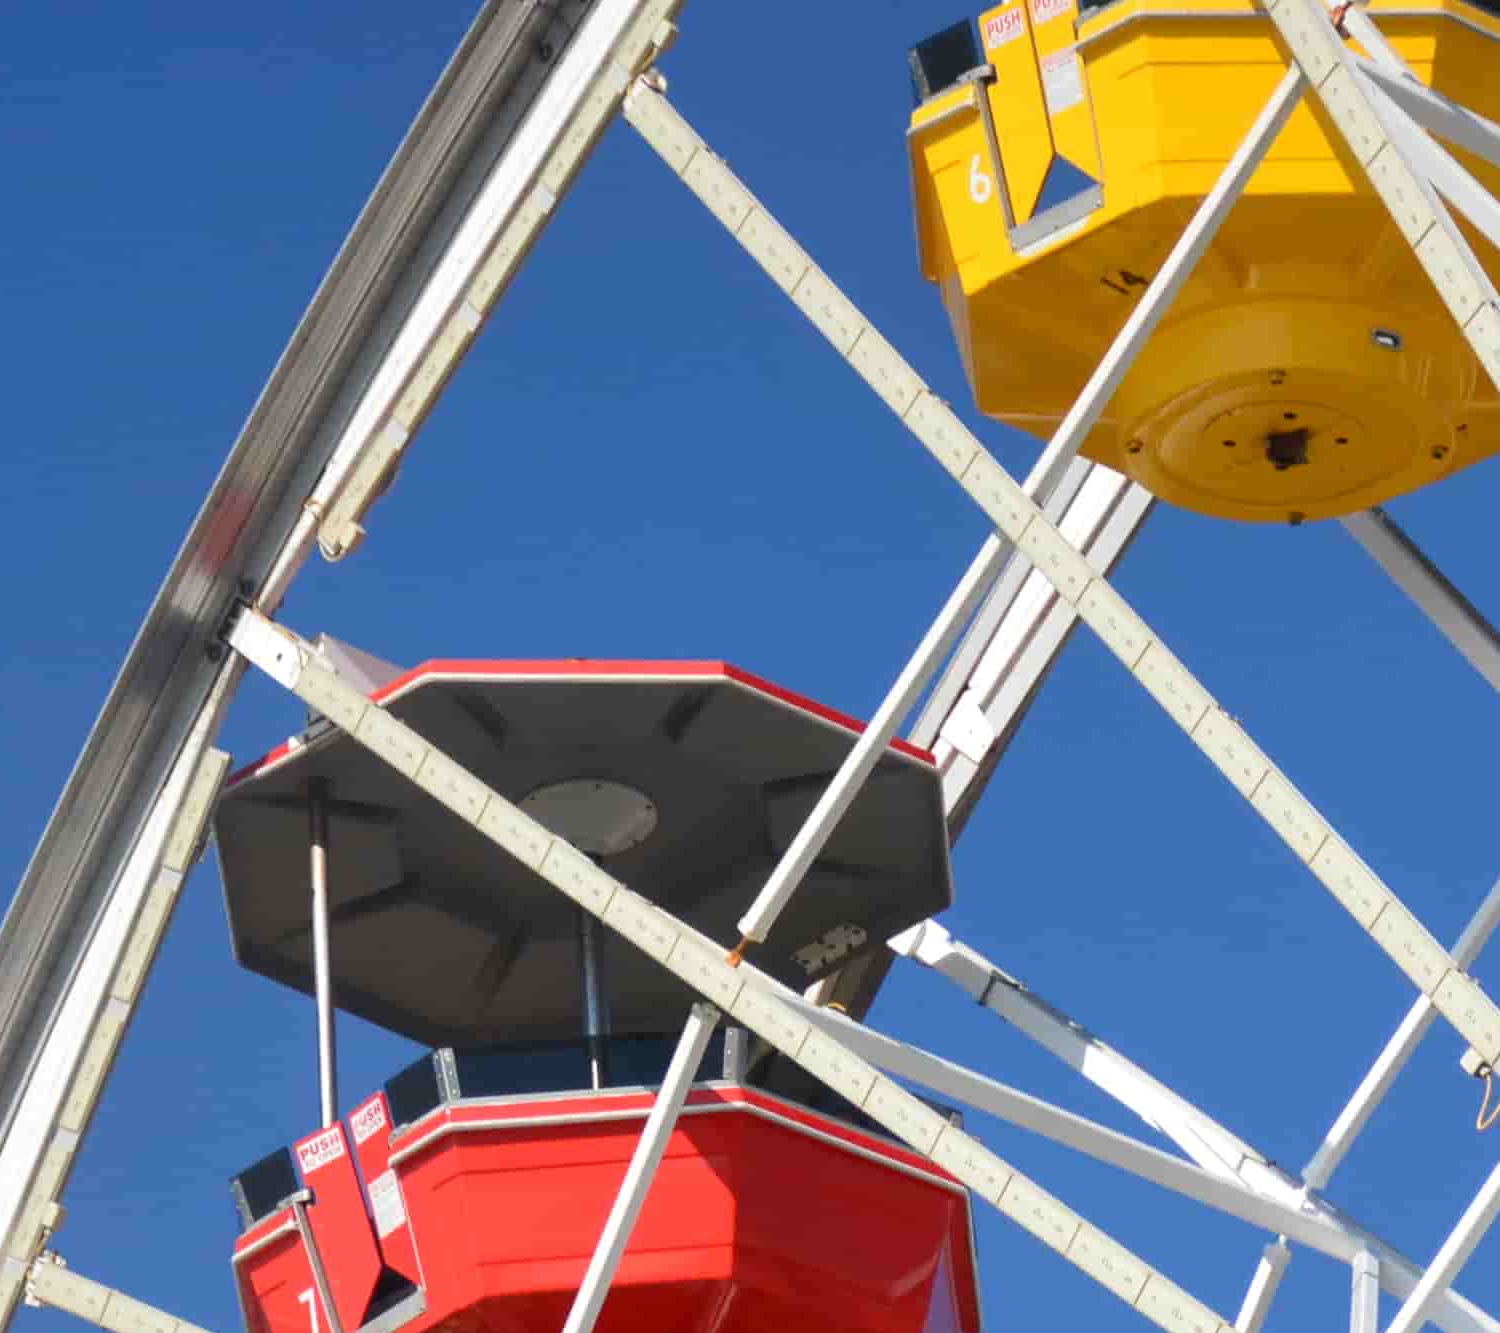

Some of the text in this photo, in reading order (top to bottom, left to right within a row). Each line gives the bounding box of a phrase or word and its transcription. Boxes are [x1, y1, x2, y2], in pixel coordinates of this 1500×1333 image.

[986, 8, 1021, 40] PUSH
[969, 154, 991, 204] 6
[300, 1131, 340, 1160] PUSH
